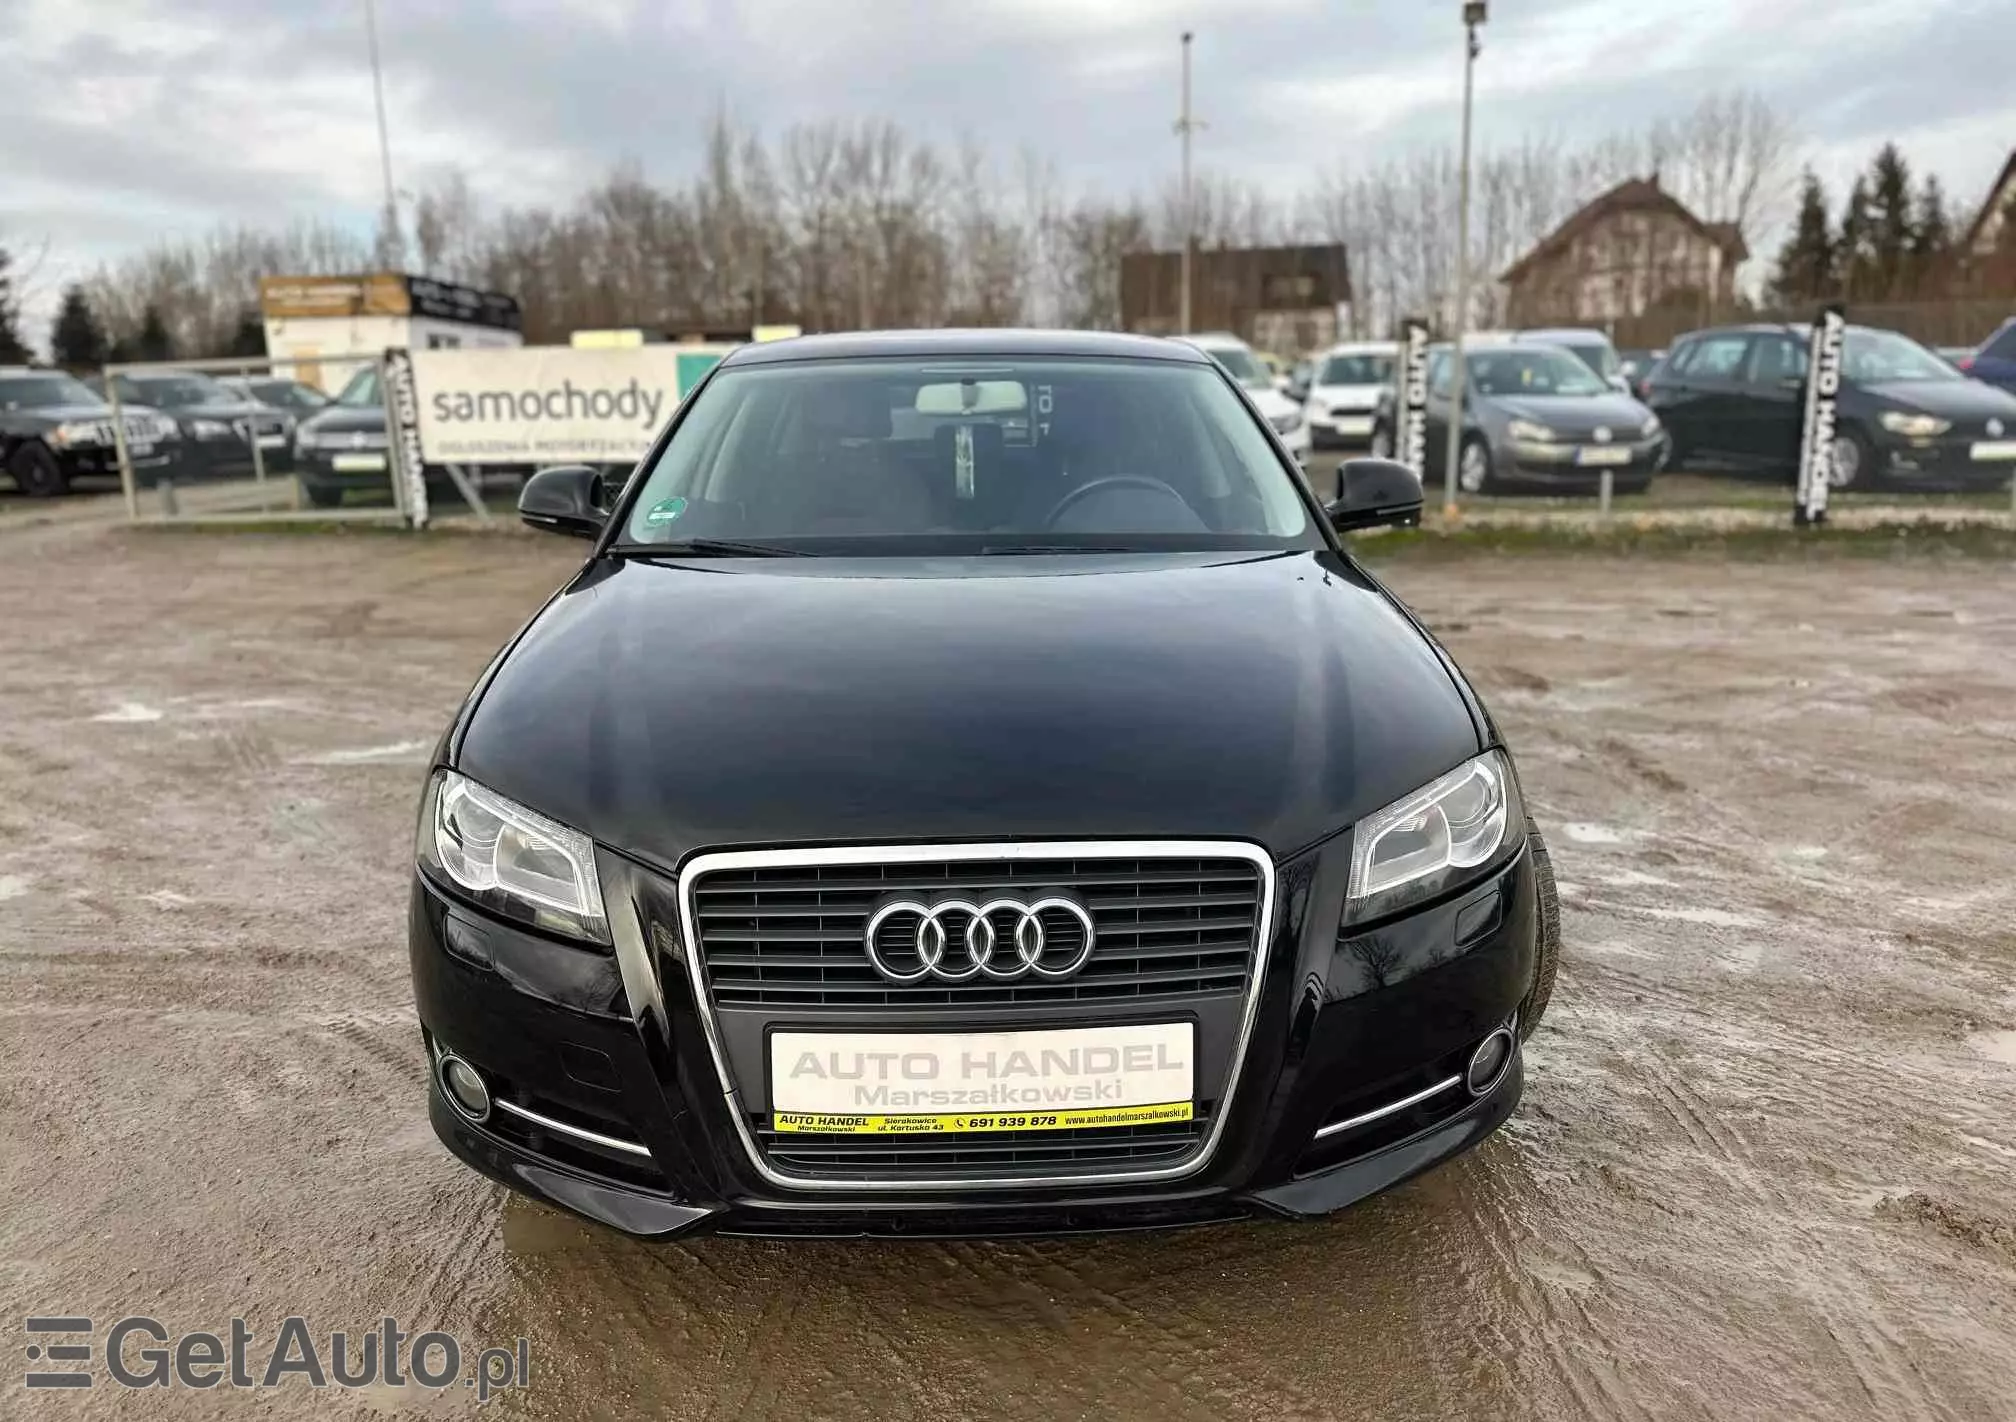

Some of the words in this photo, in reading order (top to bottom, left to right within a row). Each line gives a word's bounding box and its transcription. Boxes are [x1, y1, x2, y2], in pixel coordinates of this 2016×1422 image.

[1408, 325, 1427, 403] AUTO
[1820, 310, 1845, 394] AUTO
[433, 377, 663, 429] samochody
[789, 1051, 940, 1080] AUTO
[961, 1043, 1185, 1079] HANDEL
[854, 1079, 1123, 1107] Marszałkowski
[779, 1115, 814, 1125] AUTO
[818, 1117, 869, 1127] HANDEL
[969, 1118, 994, 1128] 691
[998, 1117, 1026, 1127] 939
[1030, 1116, 1057, 1126] 878
